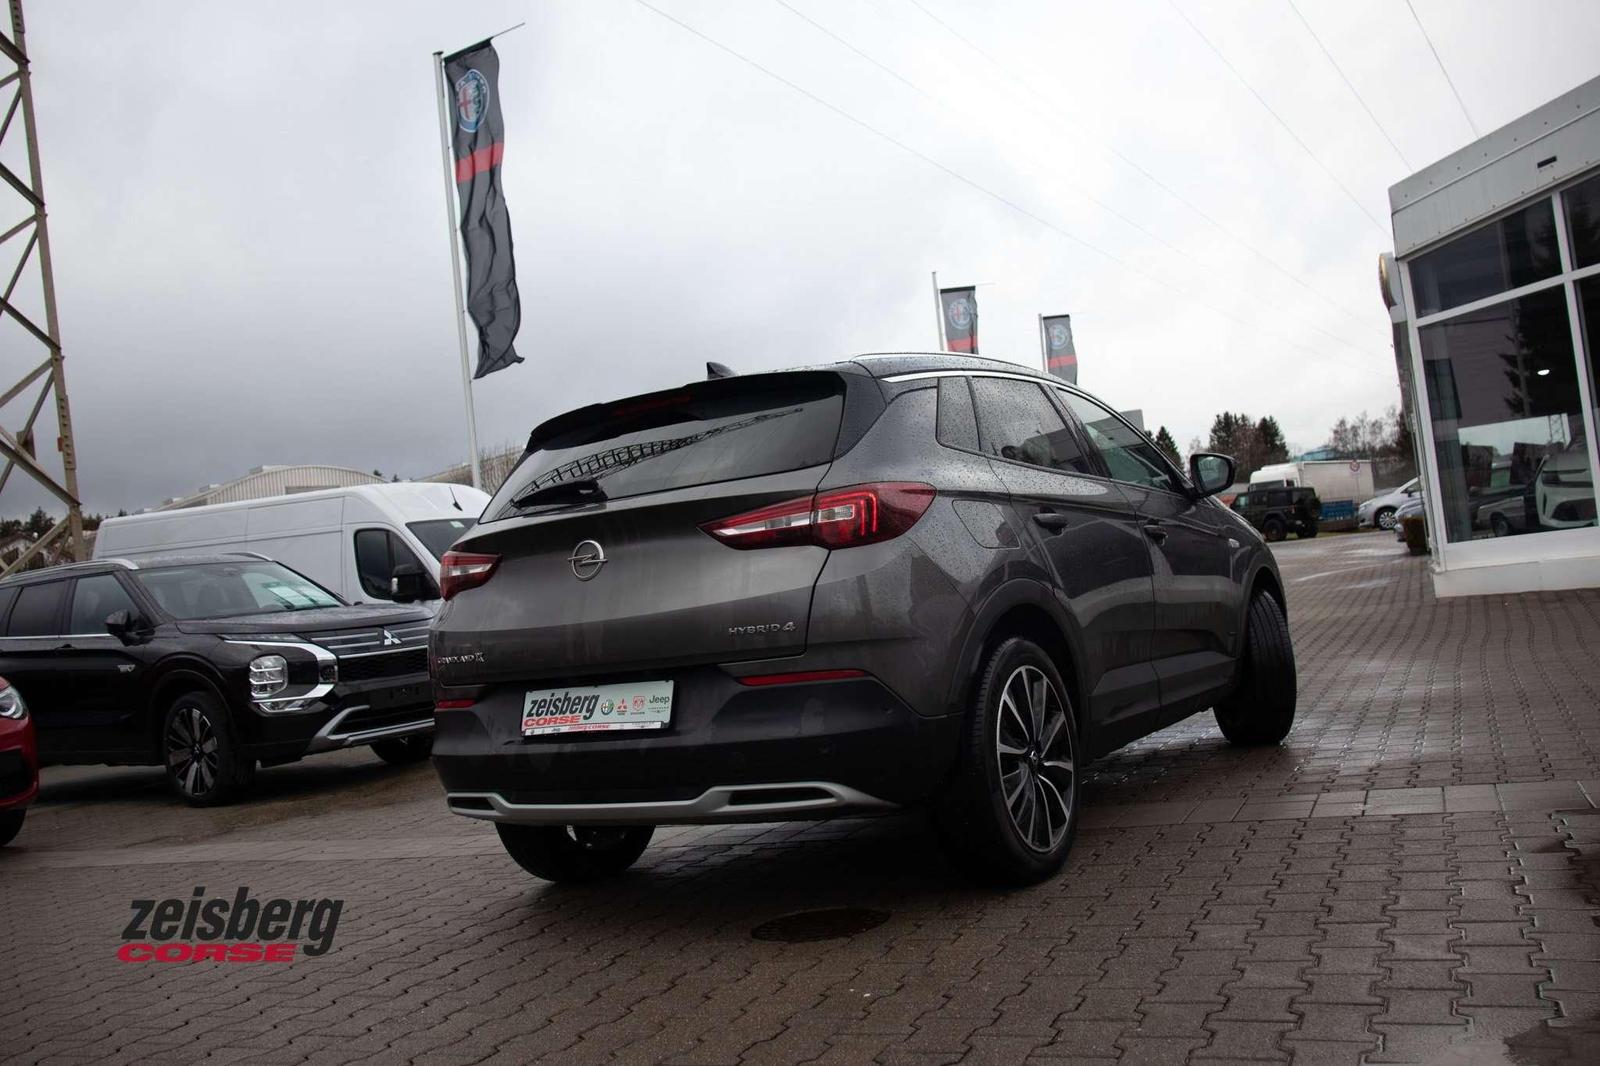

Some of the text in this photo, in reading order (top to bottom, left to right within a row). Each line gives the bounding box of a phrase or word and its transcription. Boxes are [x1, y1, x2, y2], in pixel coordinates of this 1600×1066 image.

[649, 695, 670, 704] Jeep
[526, 692, 600, 720] zeisberg
[524, 715, 581, 727] CORSE
